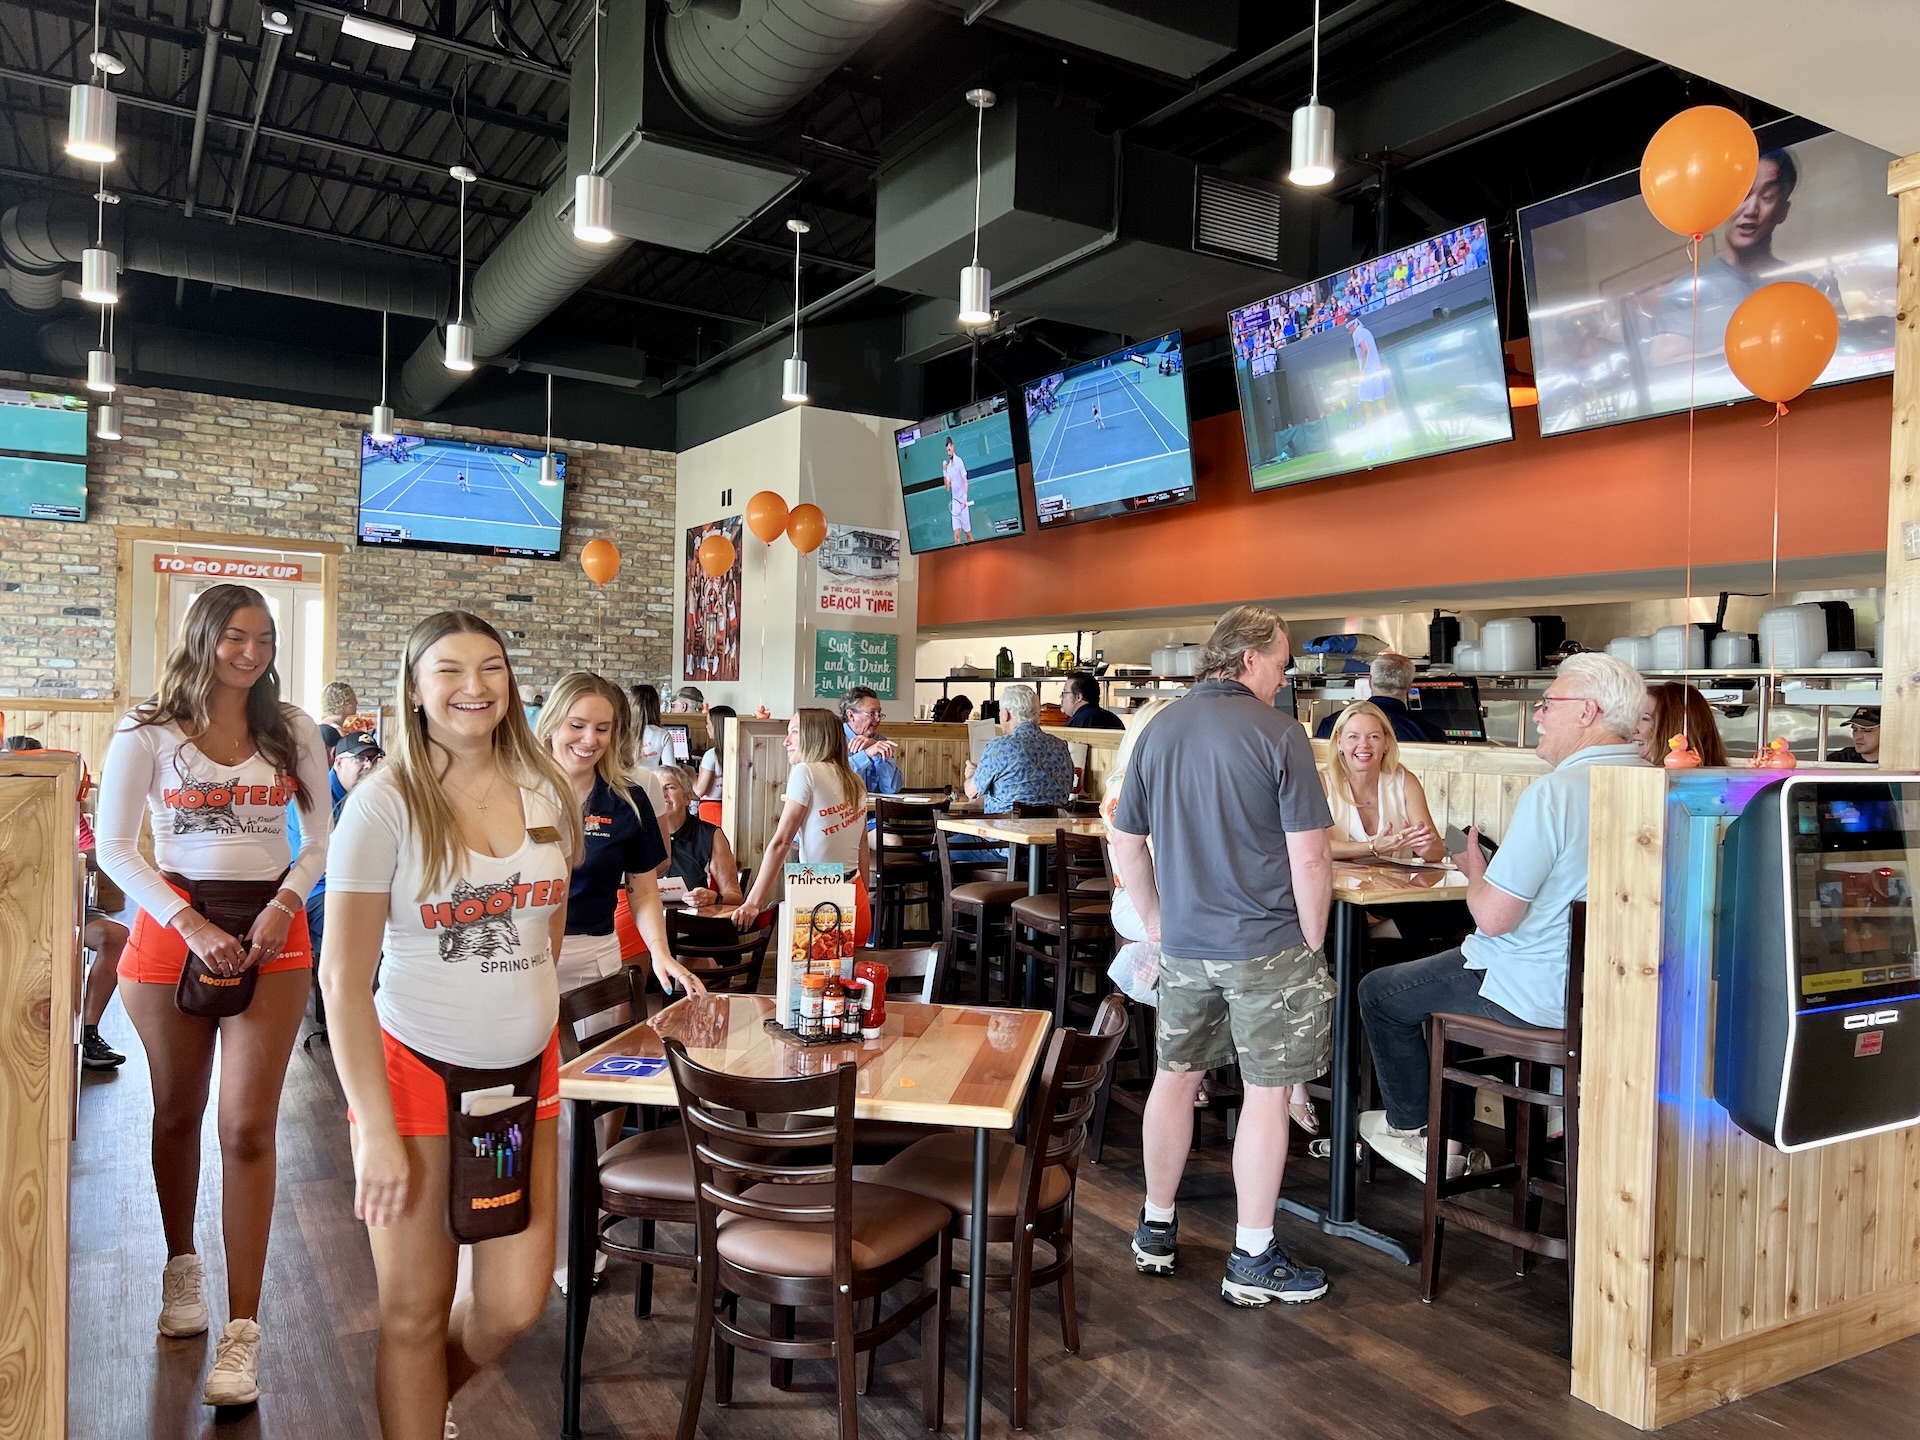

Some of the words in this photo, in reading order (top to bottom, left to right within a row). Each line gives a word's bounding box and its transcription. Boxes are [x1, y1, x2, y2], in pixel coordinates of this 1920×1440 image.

[159, 558, 222, 573] TO-GO
[223, 563, 271, 577] PICK
[272, 566, 298, 578] UP
[844, 586, 860, 594] HOUSE
[820, 594, 861, 611] BEACH
[866, 598, 894, 613] TIME
[860, 639, 888, 655] Sand
[824, 657, 845, 671] and
[847, 662, 855, 671] a
[860, 658, 891, 673] Drink
[822, 677, 834, 690] in
[837, 675, 855, 690] My
[860, 676, 891, 692] Hand!
[163, 785, 292, 809] HOOTER
[840, 808, 854, 820] TAC
[821, 824, 840, 836] YET
[420, 878, 568, 929] HOOTER
[481, 958, 529, 973] SPRING
[199, 973, 241, 987] HOOTERS
